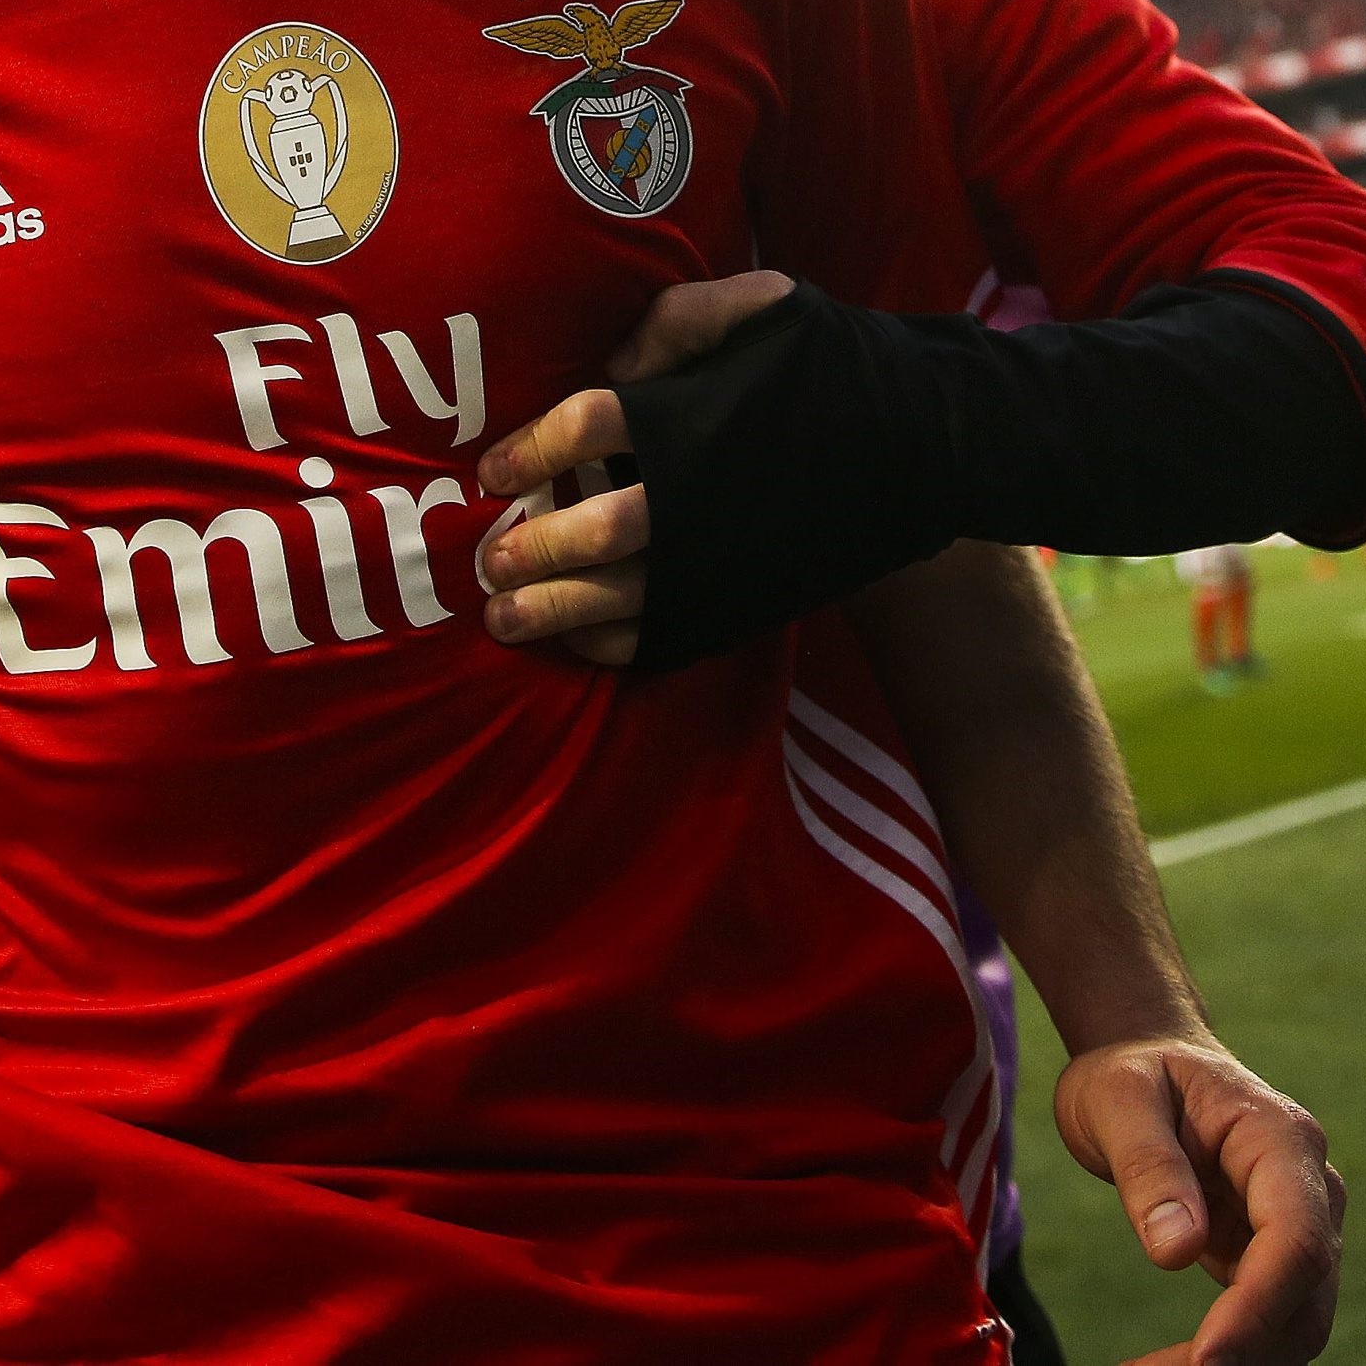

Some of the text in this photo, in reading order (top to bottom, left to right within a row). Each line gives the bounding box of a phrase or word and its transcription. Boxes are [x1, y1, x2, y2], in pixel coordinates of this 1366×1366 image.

[221, 35, 351, 93] CAMPEÃO
[373, 170, 392, 214] PORTUGAL
[213, 312, 486, 452] Fly
